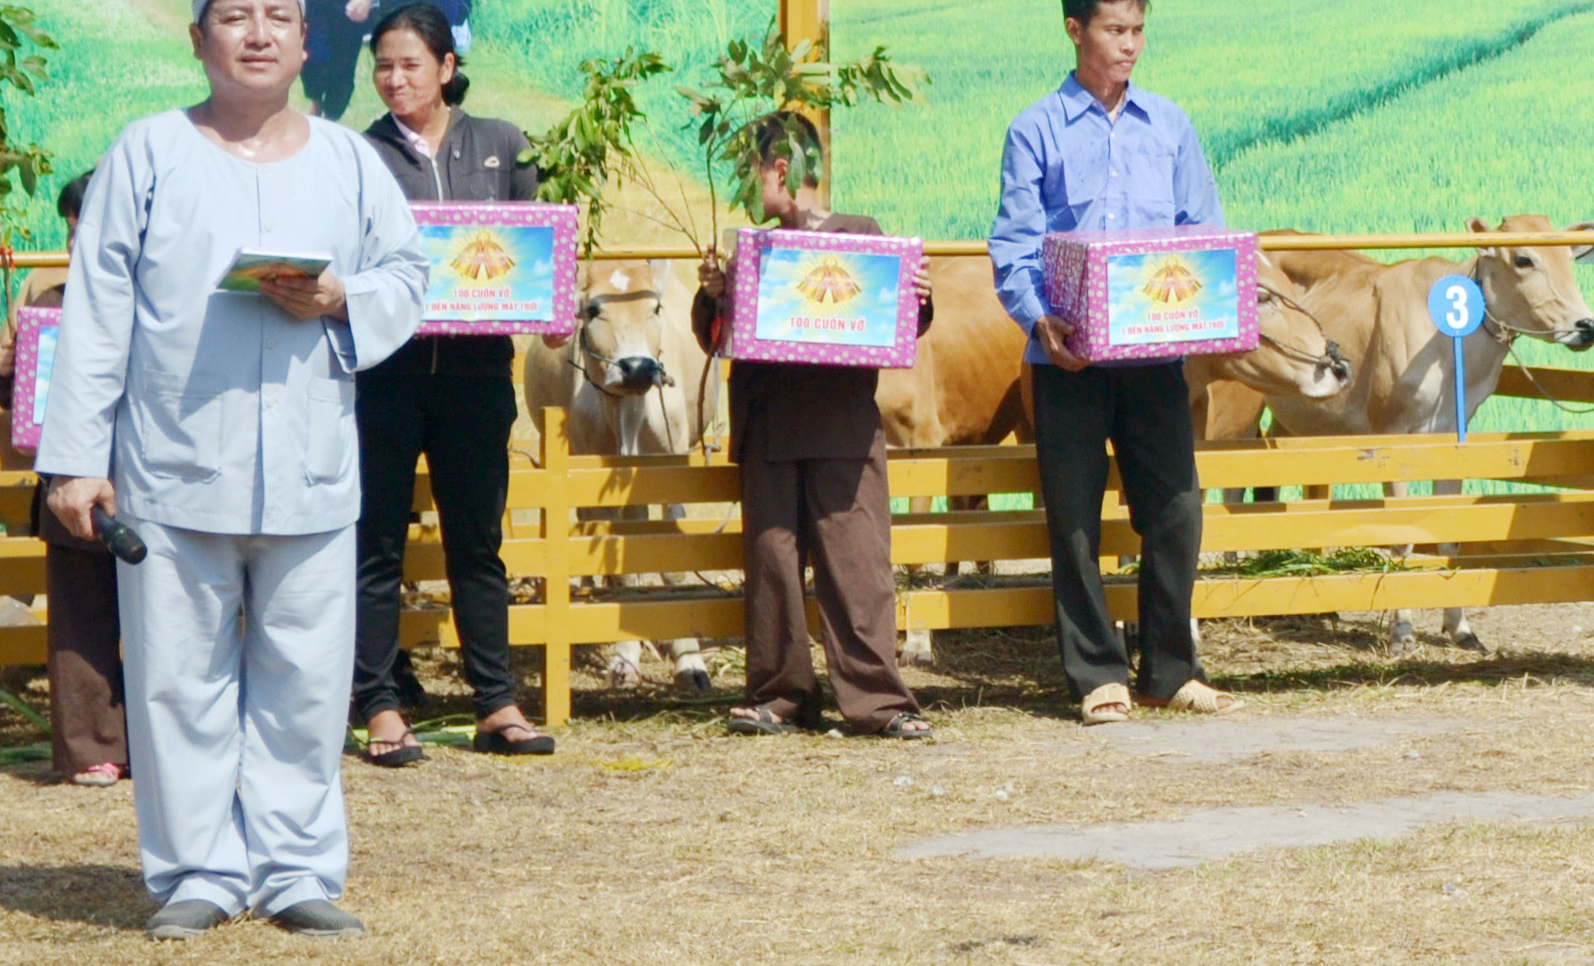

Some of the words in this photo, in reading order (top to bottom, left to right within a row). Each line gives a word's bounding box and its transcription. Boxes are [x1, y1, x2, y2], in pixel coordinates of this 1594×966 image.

[454, 289, 469, 298] 100
[1446, 284, 1469, 328] 3
[1147, 313, 1160, 321] 100
[790, 317, 810, 329] 100
